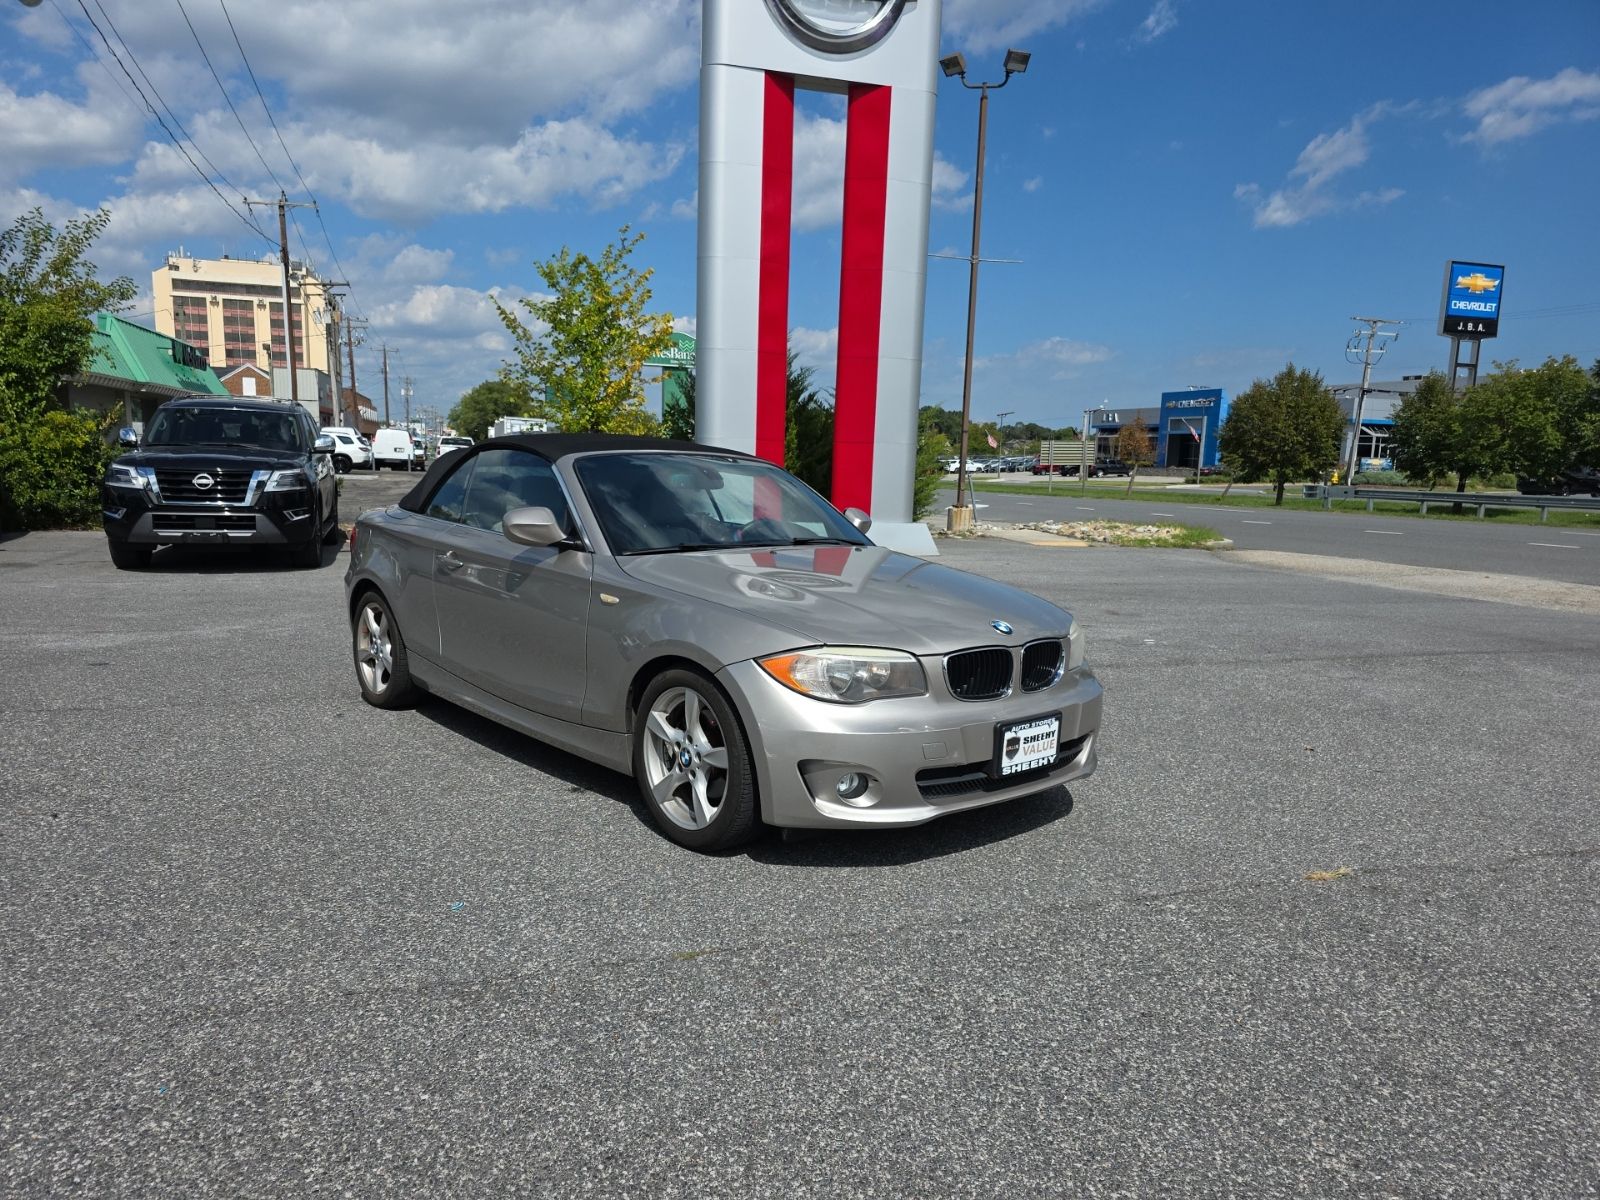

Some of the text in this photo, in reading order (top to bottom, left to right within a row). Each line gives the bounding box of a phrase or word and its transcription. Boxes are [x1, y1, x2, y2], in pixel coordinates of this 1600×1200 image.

[1451, 300, 1497, 312] CHEVROLET
[1010, 723, 1031, 733] AUTO
[1023, 730, 1056, 745] SHEEHY
[1022, 738, 1056, 756] VALUE
[1002, 754, 1057, 776] SHEEHY
